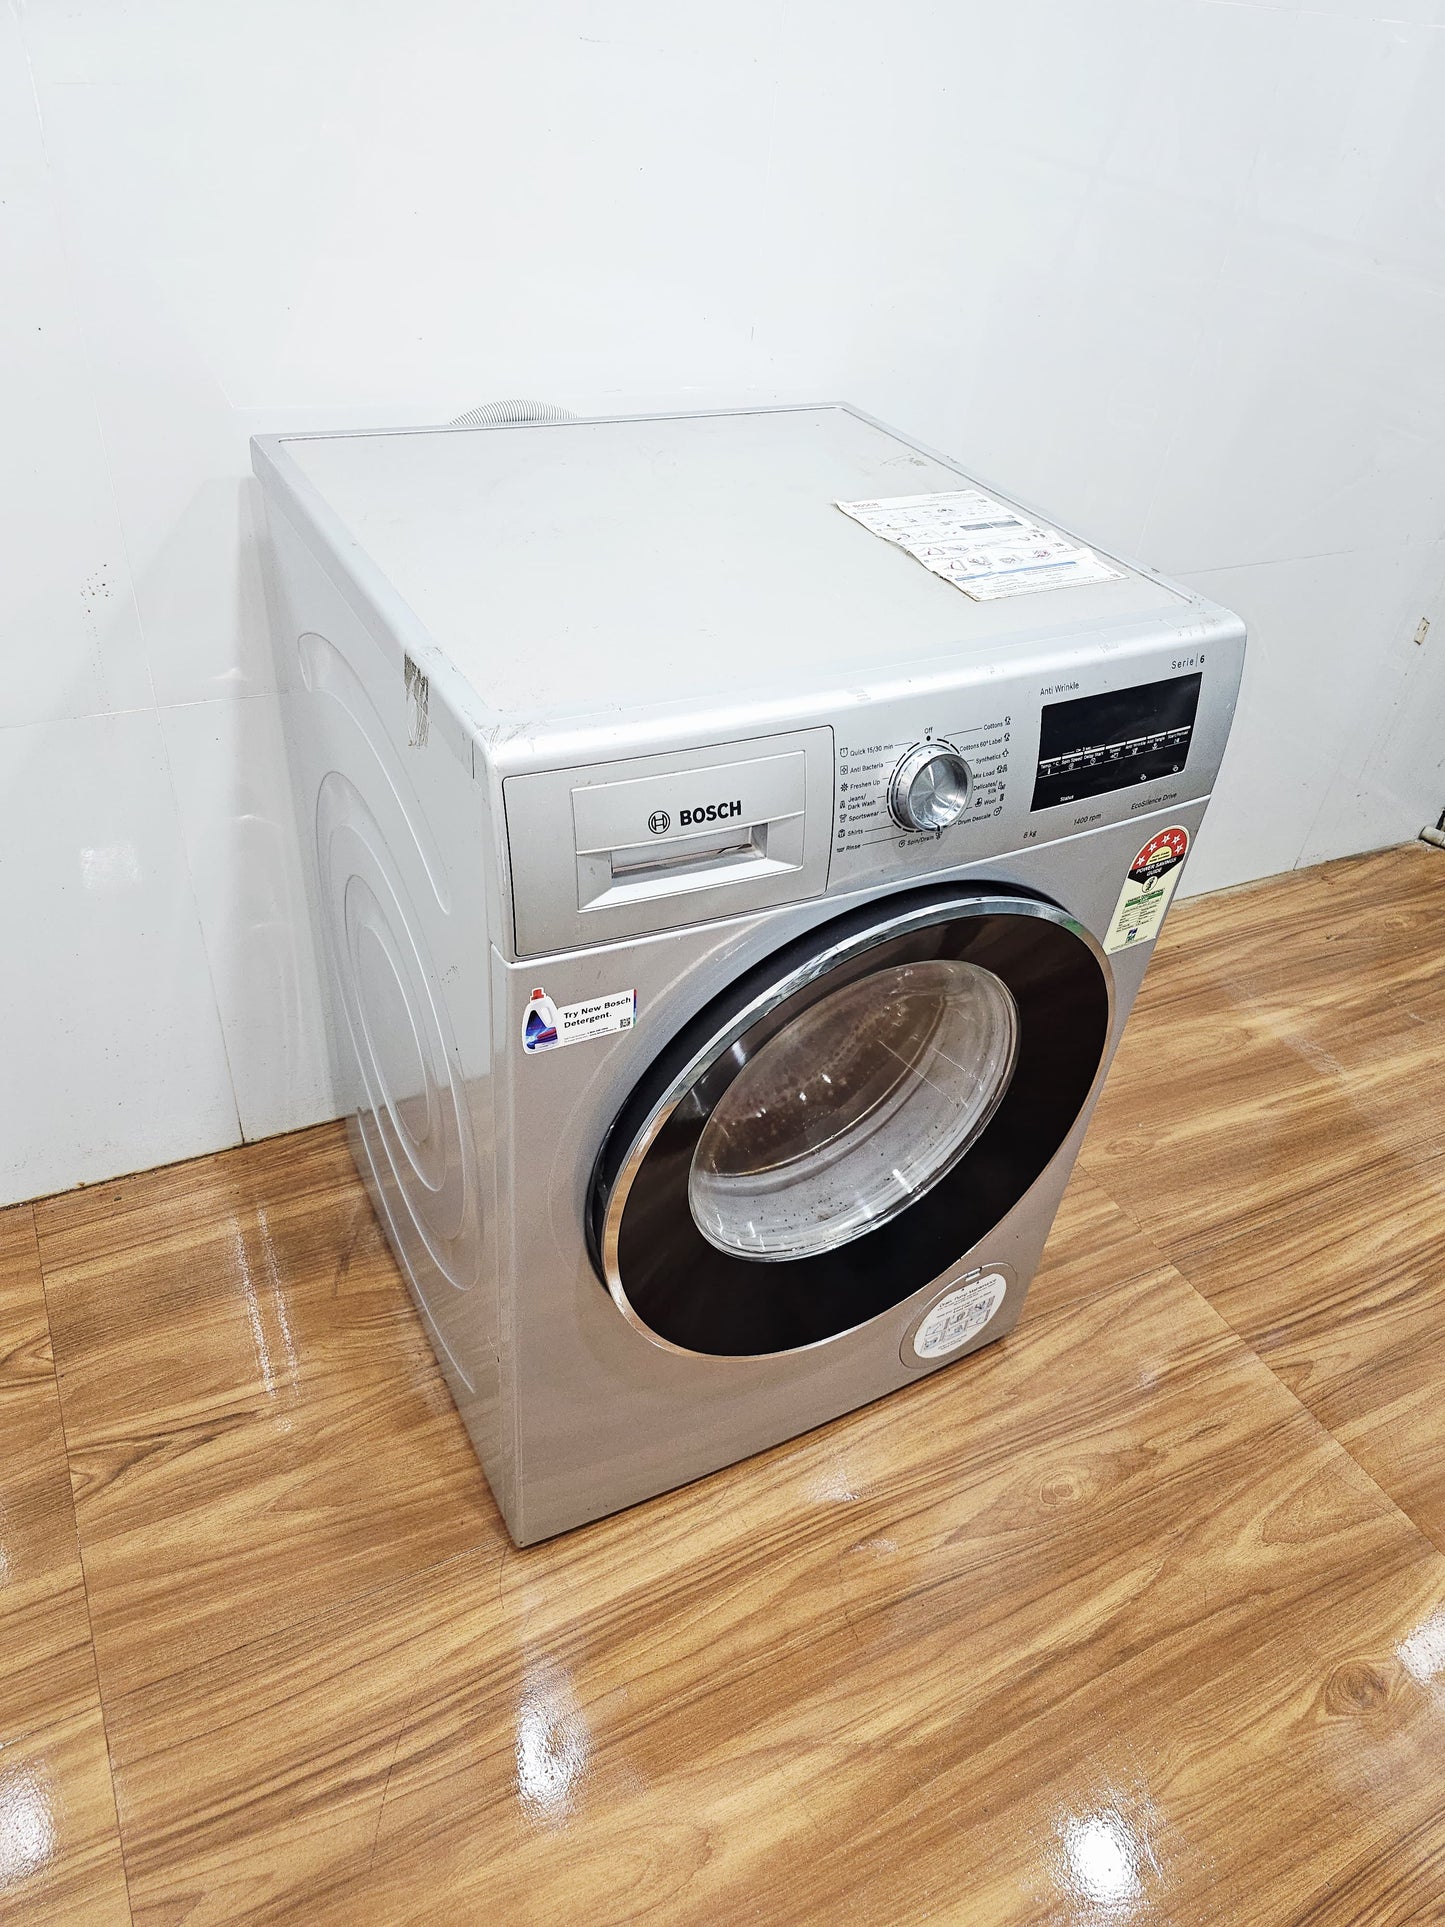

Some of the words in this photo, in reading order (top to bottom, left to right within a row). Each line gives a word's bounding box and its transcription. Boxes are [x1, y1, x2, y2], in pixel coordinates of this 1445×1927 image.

[1171, 658, 1194, 670] Serie
[1199, 655, 1206, 663] 6
[1039, 687, 1053, 696] Anti
[1055, 682, 1080, 693] Wrinkle
[983, 721, 1003, 731] Cottons
[959, 743, 979, 752] Cottons
[989, 737, 1003, 746] Label
[850, 749, 866, 757] Quick
[867, 746, 882, 754] 15/30
[976, 753, 1001, 765] Synthetics
[862, 763, 884, 772] Bacteria
[983, 769, 996, 777] Load
[850, 782, 872, 790] Freshen
[973, 780, 998, 791] Delicates/
[848, 794, 867, 803] Jeans/
[983, 798, 997, 806] Wool
[1131, 795, 1162, 811] EcoSilence
[1162, 791, 1178, 803] Drive
[680, 800, 742, 827] BOSCH
[848, 811, 880, 822] Sportswear
[1073, 816, 1089, 825] 1400
[1088, 813, 1102, 822] rpm
[957, 818, 972, 826] Drum
[972, 813, 991, 822] Descale
[1029, 830, 1037, 838] kg
[906, 835, 934, 846] Spin/Drain
[1136, 864, 1155, 874] POWER
[1155, 857, 1178, 867] SAVINGS
[1146, 867, 1163, 876] GUIDE
[581, 1005, 601, 1014] New
[604, 997, 631, 1009] Bosch
[564, 1011, 612, 1029] Detergent.
